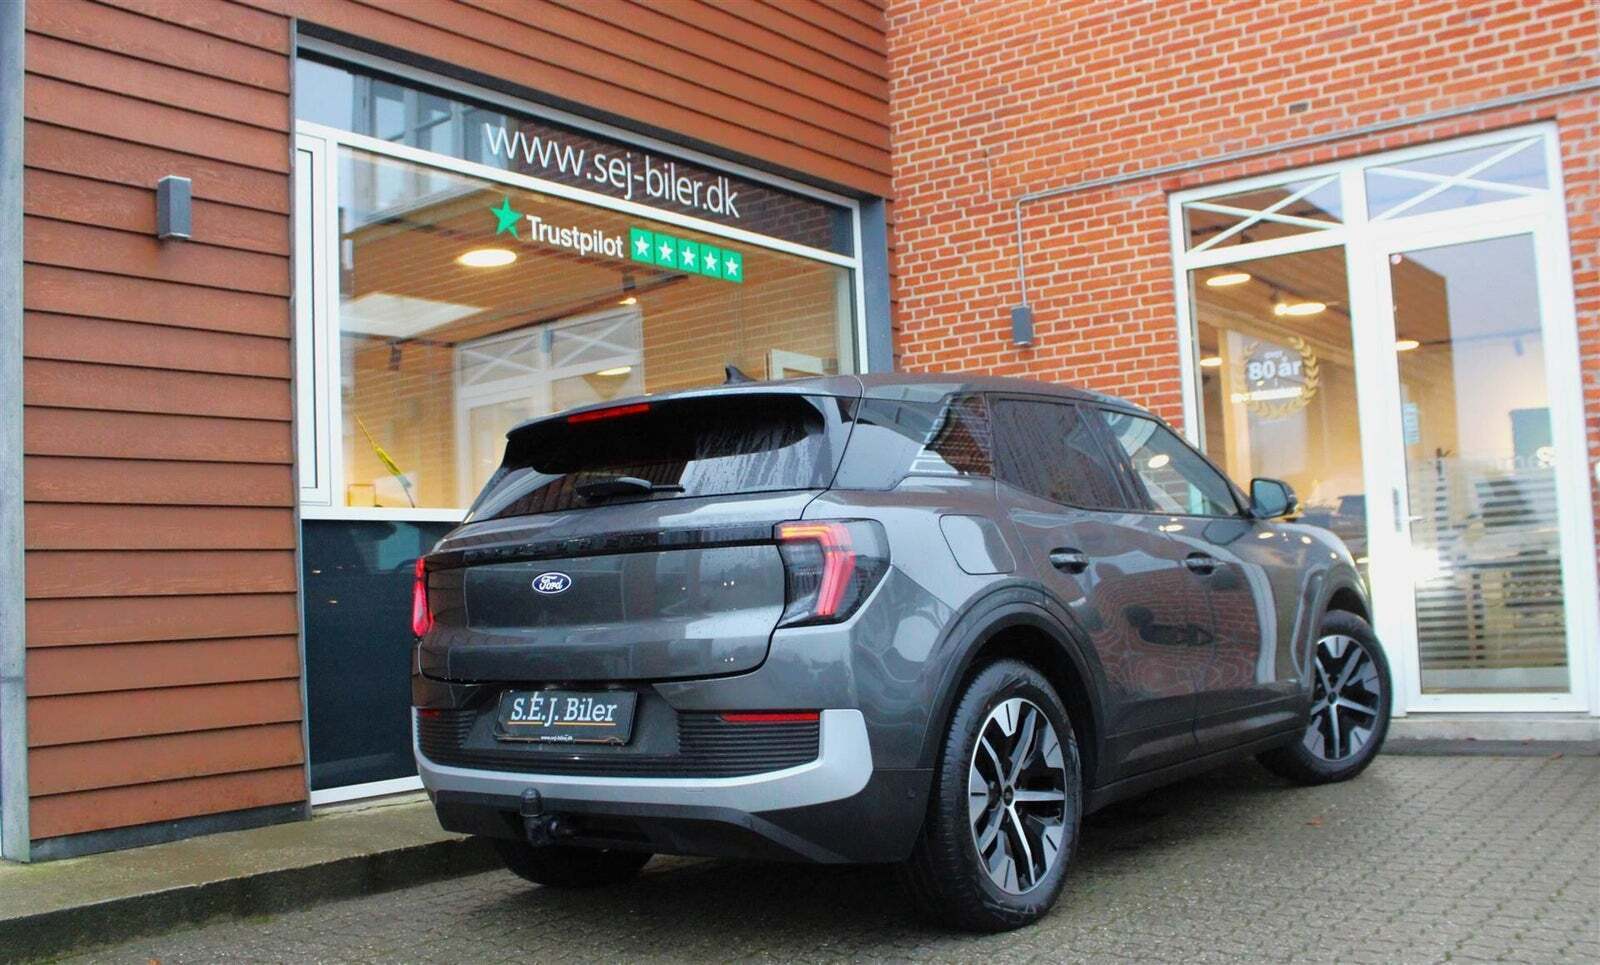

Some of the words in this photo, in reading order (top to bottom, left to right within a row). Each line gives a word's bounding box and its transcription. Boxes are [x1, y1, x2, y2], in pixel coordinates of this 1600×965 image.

[484, 122, 741, 218] www.sej-biler.dk
[525, 214, 625, 258] Trustpilot
[1247, 360, 1276, 381] 80
[1278, 355, 1302, 377] år
[537, 574, 566, 591] Ford
[563, 697, 617, 722] Biler
